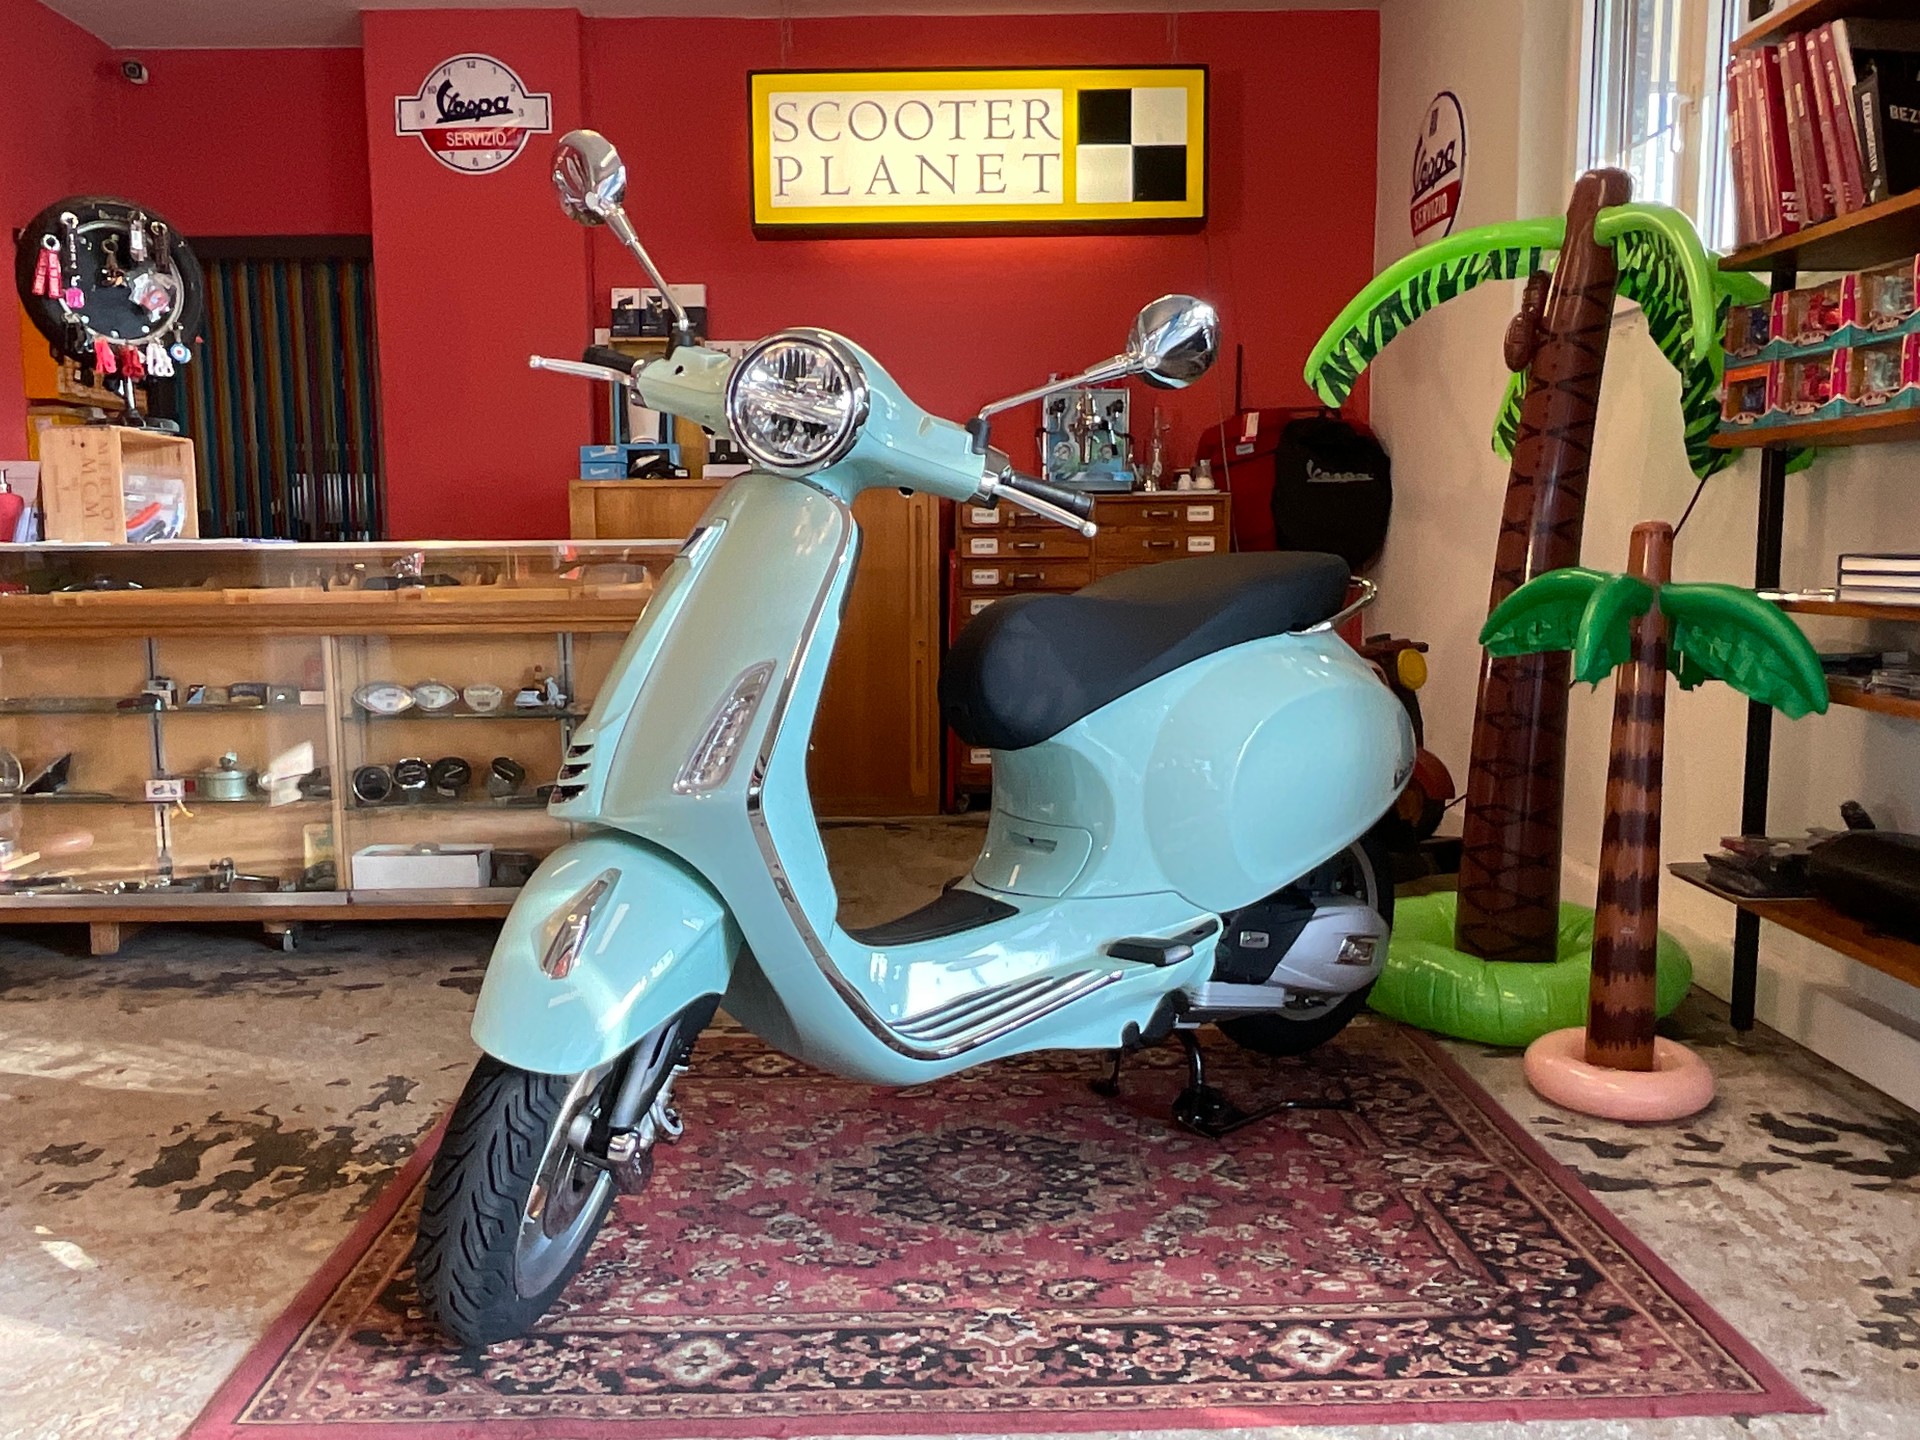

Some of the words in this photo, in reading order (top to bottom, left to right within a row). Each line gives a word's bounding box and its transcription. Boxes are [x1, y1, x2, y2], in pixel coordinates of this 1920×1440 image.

[436, 79, 514, 124] Vespa
[773, 98, 1061, 142] SCOOTER
[1888, 104, 1920, 124] BEZ
[446, 132, 507, 147] SERVIZIO
[773, 153, 1060, 197] PLANET
[1411, 139, 1457, 204] Vespa
